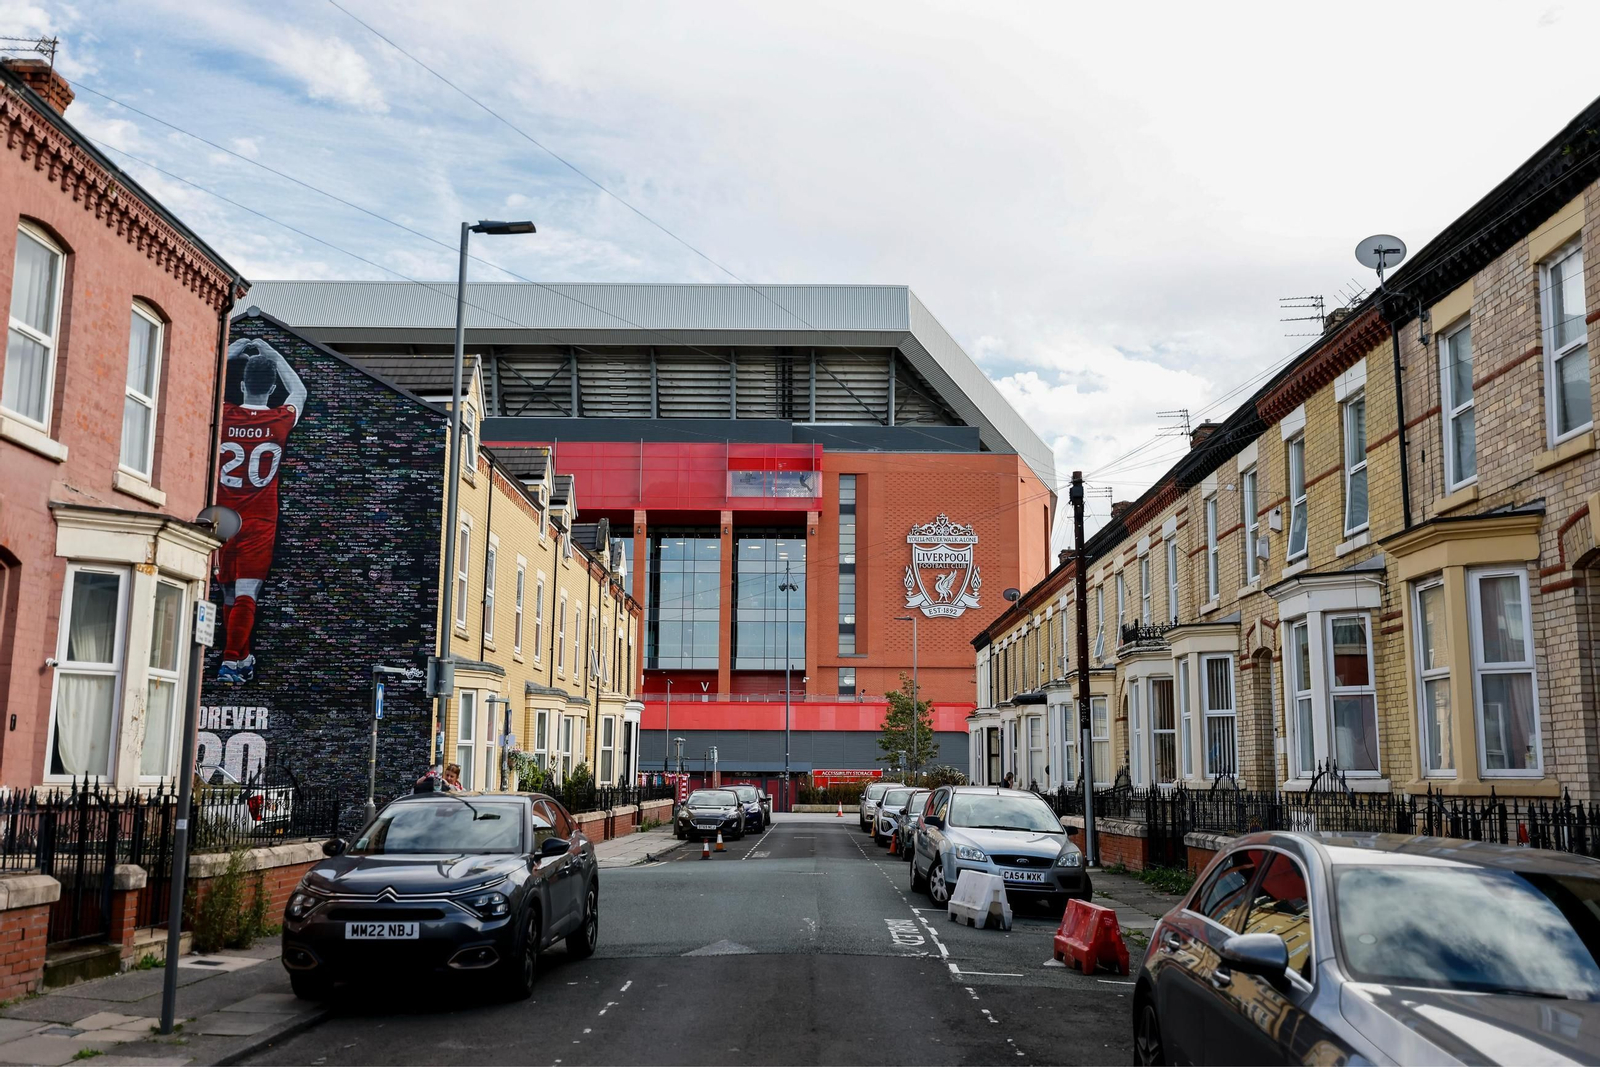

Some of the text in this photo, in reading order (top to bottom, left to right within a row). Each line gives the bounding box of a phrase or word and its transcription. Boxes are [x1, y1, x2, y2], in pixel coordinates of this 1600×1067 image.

[228, 427, 274, 438] DIOGO J.
[220, 442, 282, 488] 20
[917, 552, 969, 562] LIVERPOOL
[197, 706, 268, 730] OREVER
[1003, 871, 1025, 880] CA54
[351, 924, 414, 937] MM22 NBJ
